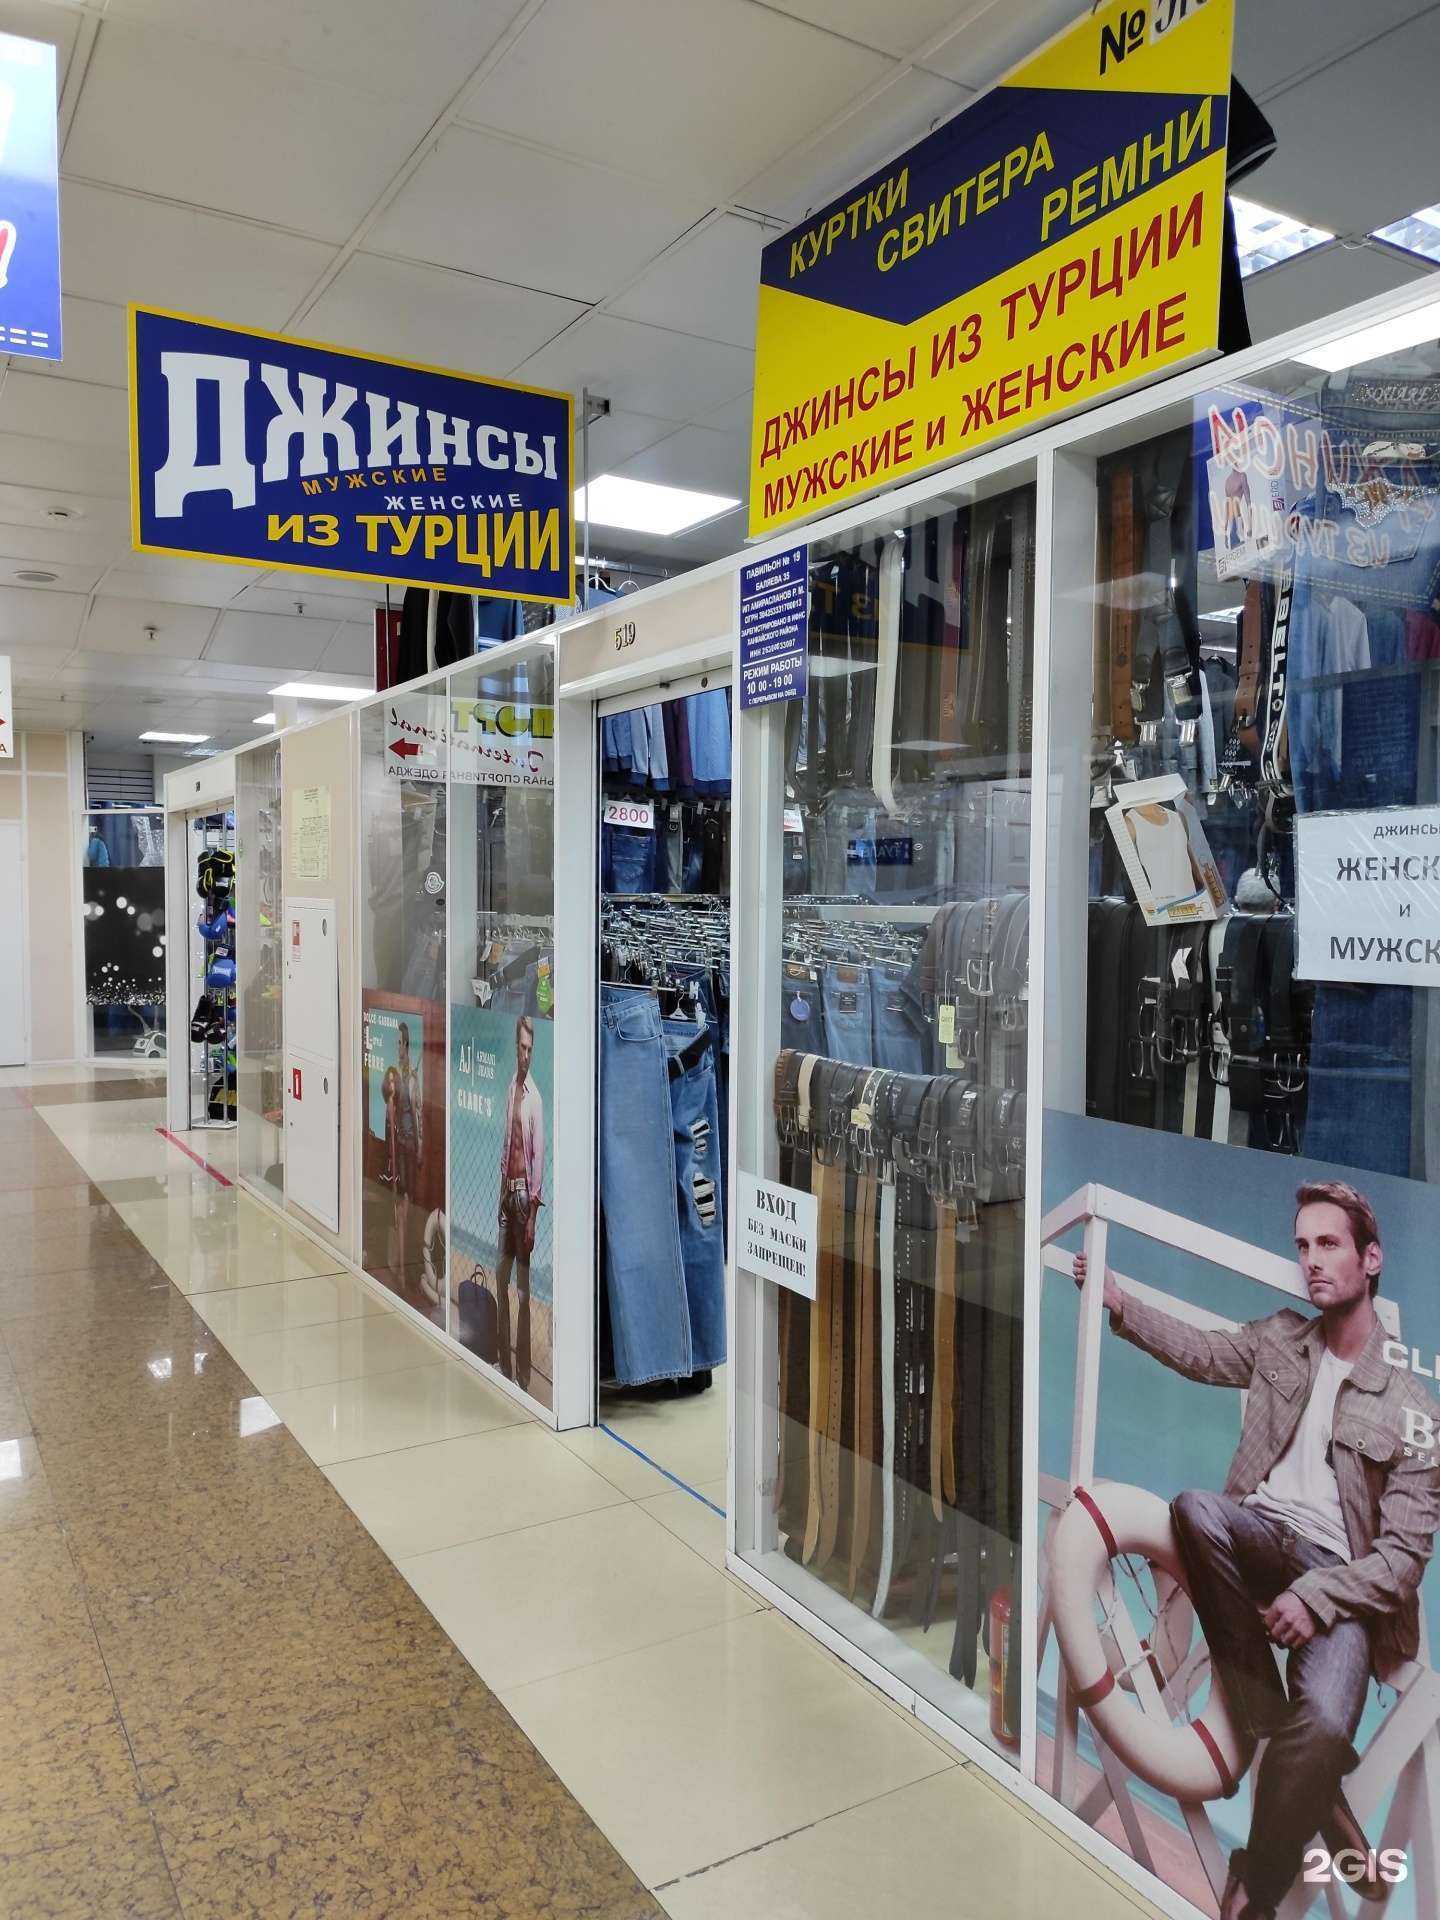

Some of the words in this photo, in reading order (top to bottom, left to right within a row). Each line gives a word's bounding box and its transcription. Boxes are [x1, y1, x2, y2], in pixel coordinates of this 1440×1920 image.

[1040, 96, 1213, 242] РЕМНИ
[876, 131, 1055, 272] СВИТЕРА
[789, 167, 909, 279] КУРТКИ
[760, 348, 916, 467] ДЖИНСЫ
[931, 313, 982, 379] ИЗ
[1001, 190, 1204, 341] ТУРЦИИ
[763, 420, 914, 518] МУЖСКИЕ
[960, 292, 1187, 438] ЖЕНСКИЕ
[155, 352, 557, 518] ДЖИНСЫ
[302, 467, 447, 495] МУЖСКИЕ
[384, 493, 523, 511] ЖЕНСКИЕ
[267, 514, 339, 546] ИЗ
[356, 508, 560, 578] ТУРЦИИ
[746, 558, 781, 579] ПАВИЛЬОН
[793, 550, 800, 562] 19
[755, 574, 781, 591] БАЛЯЕВА
[783, 571, 789, 581] 35
[615, 621, 635, 651] 519
[743, 664, 768, 681] РЕЖИМ
[770, 655, 802, 674] РАБОТЫ
[773, 675, 781, 688] 19
[783, 672, 792, 686] 00
[608, 806, 650, 825] 2800
[1337, 856, 1440, 881] ЖЕНСК
[1330, 937, 1440, 964] МУЖСК
[459, 1044, 471, 1074] AJ
[756, 1189, 798, 1225] ВХОД
[748, 1218, 764, 1236] БЕЗ
[770, 1227, 807, 1253] МАСКИ
[747, 1241, 806, 1277] ЗАПРЕЩЕН!
